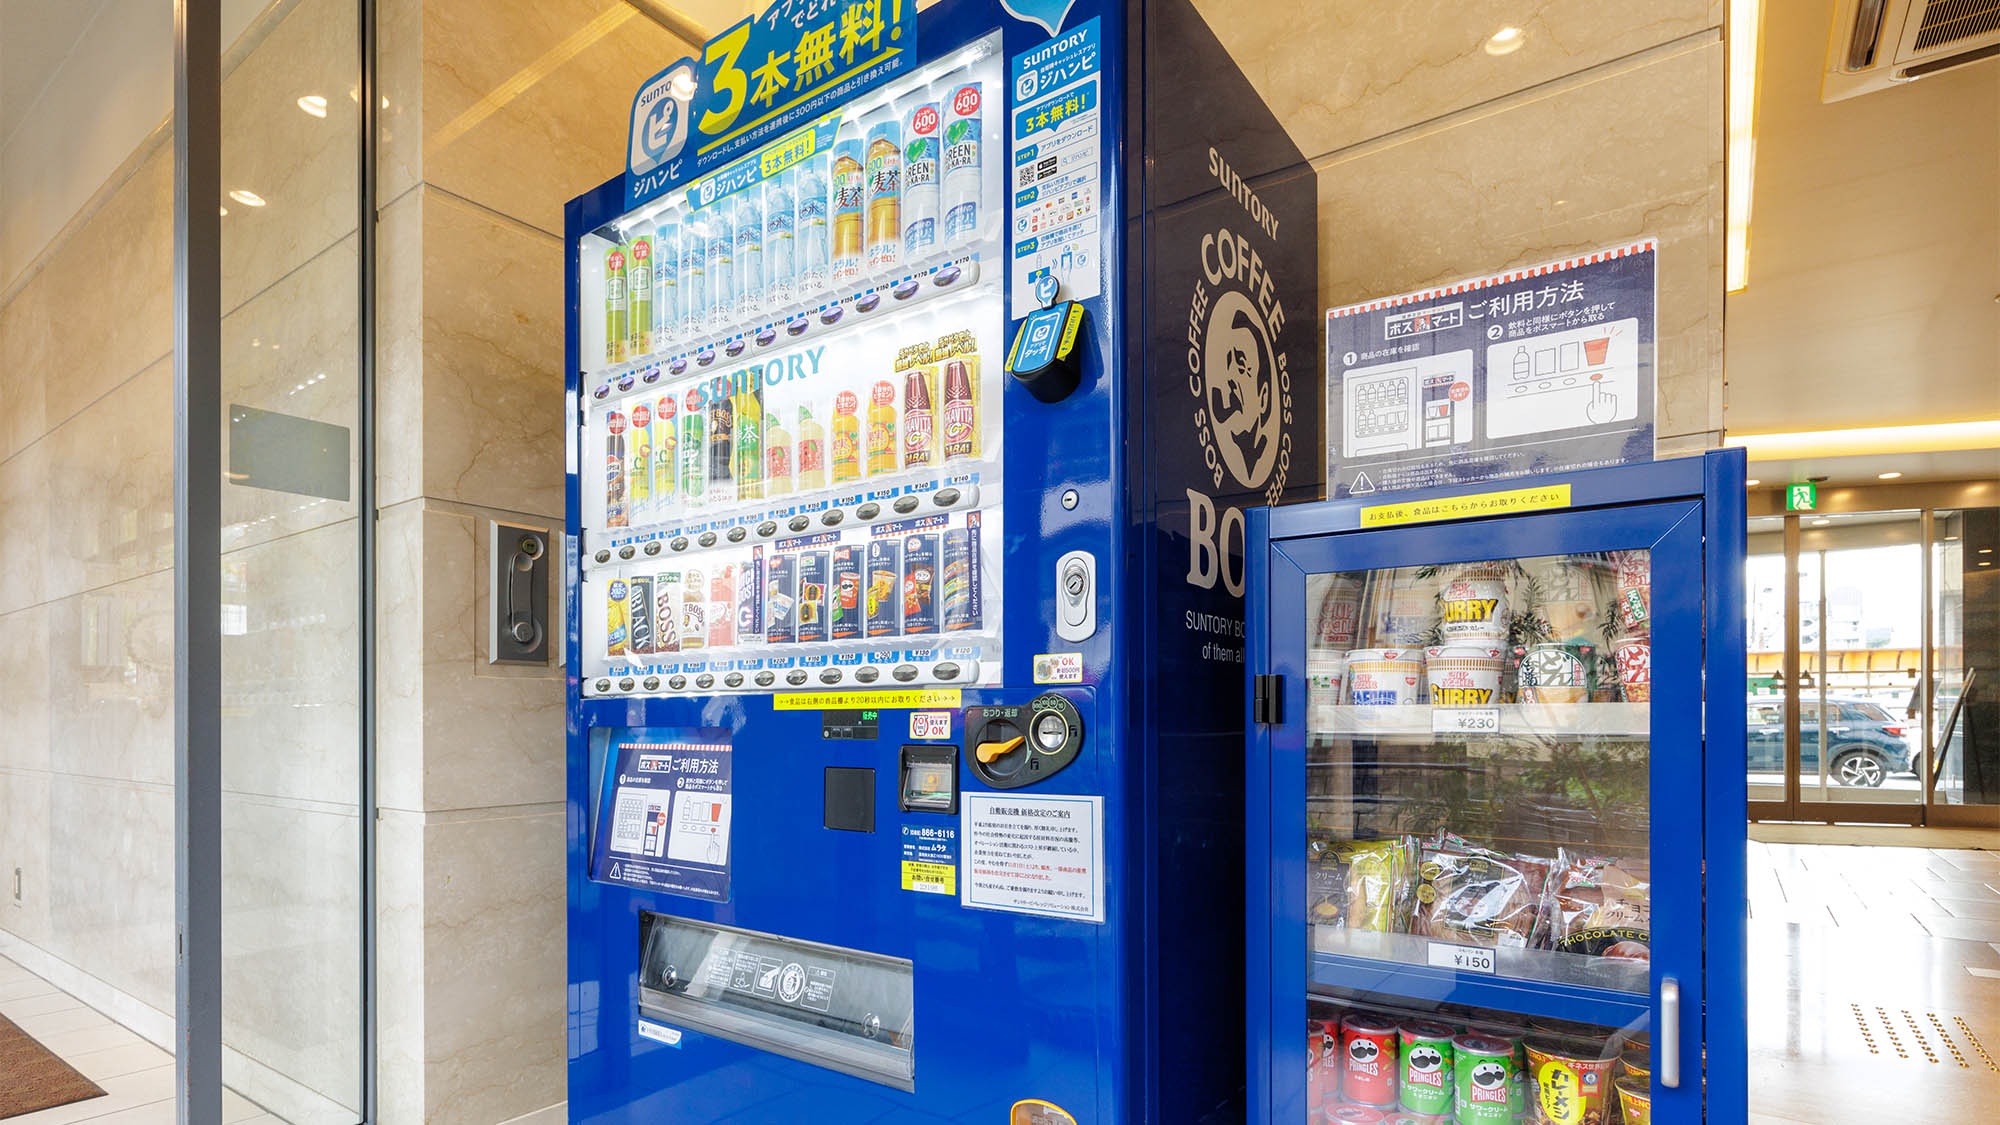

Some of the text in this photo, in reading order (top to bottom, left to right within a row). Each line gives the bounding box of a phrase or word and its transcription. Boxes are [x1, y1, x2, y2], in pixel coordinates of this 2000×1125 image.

[1024, 29, 1087, 70] SUNTORY
[1040, 51, 1096, 90] ジハンピ
[641, 81, 672, 107] SUNTO
[956, 93, 978, 112] 600
[914, 114, 936, 131] 600
[1025, 94, 1086, 133] 3本無料!
[765, 138, 810, 173] 3本無料!
[634, 159, 683, 199] ジハンピ
[716, 166, 757, 197] ジハンピ
[1208, 146, 1279, 241] SUNTORY
[1201, 228, 1285, 343] COFFEE
[1468, 280, 1585, 319] ご利用方法
[696, 345, 825, 408] SUNTORY
[1188, 279, 1224, 489] BOSS COFFEE
[1278, 352, 1293, 425] BOSS
[1186, 487, 1245, 598] BO
[657, 591, 677, 646] BOSS
[1185, 609, 1246, 638] SUNTORY BO
[1062, 657, 1074, 666] OK
[1202, 642, 1212, 660] of
[1213, 643, 1233, 662] them
[1431, 683, 1493, 704] CURRY
[932, 726, 944, 736] OK
[1457, 718, 1495, 729] ¥230
[672, 757, 718, 774] ご利用方法
[1314, 872, 1343, 881] クリーム
[1454, 954, 1490, 969] ¥150
[1349, 1058, 1379, 1077] PRINGLES
[1408, 1067, 1443, 1087] PRINGLES
[1471, 1086, 1507, 1103] PRINGLES
